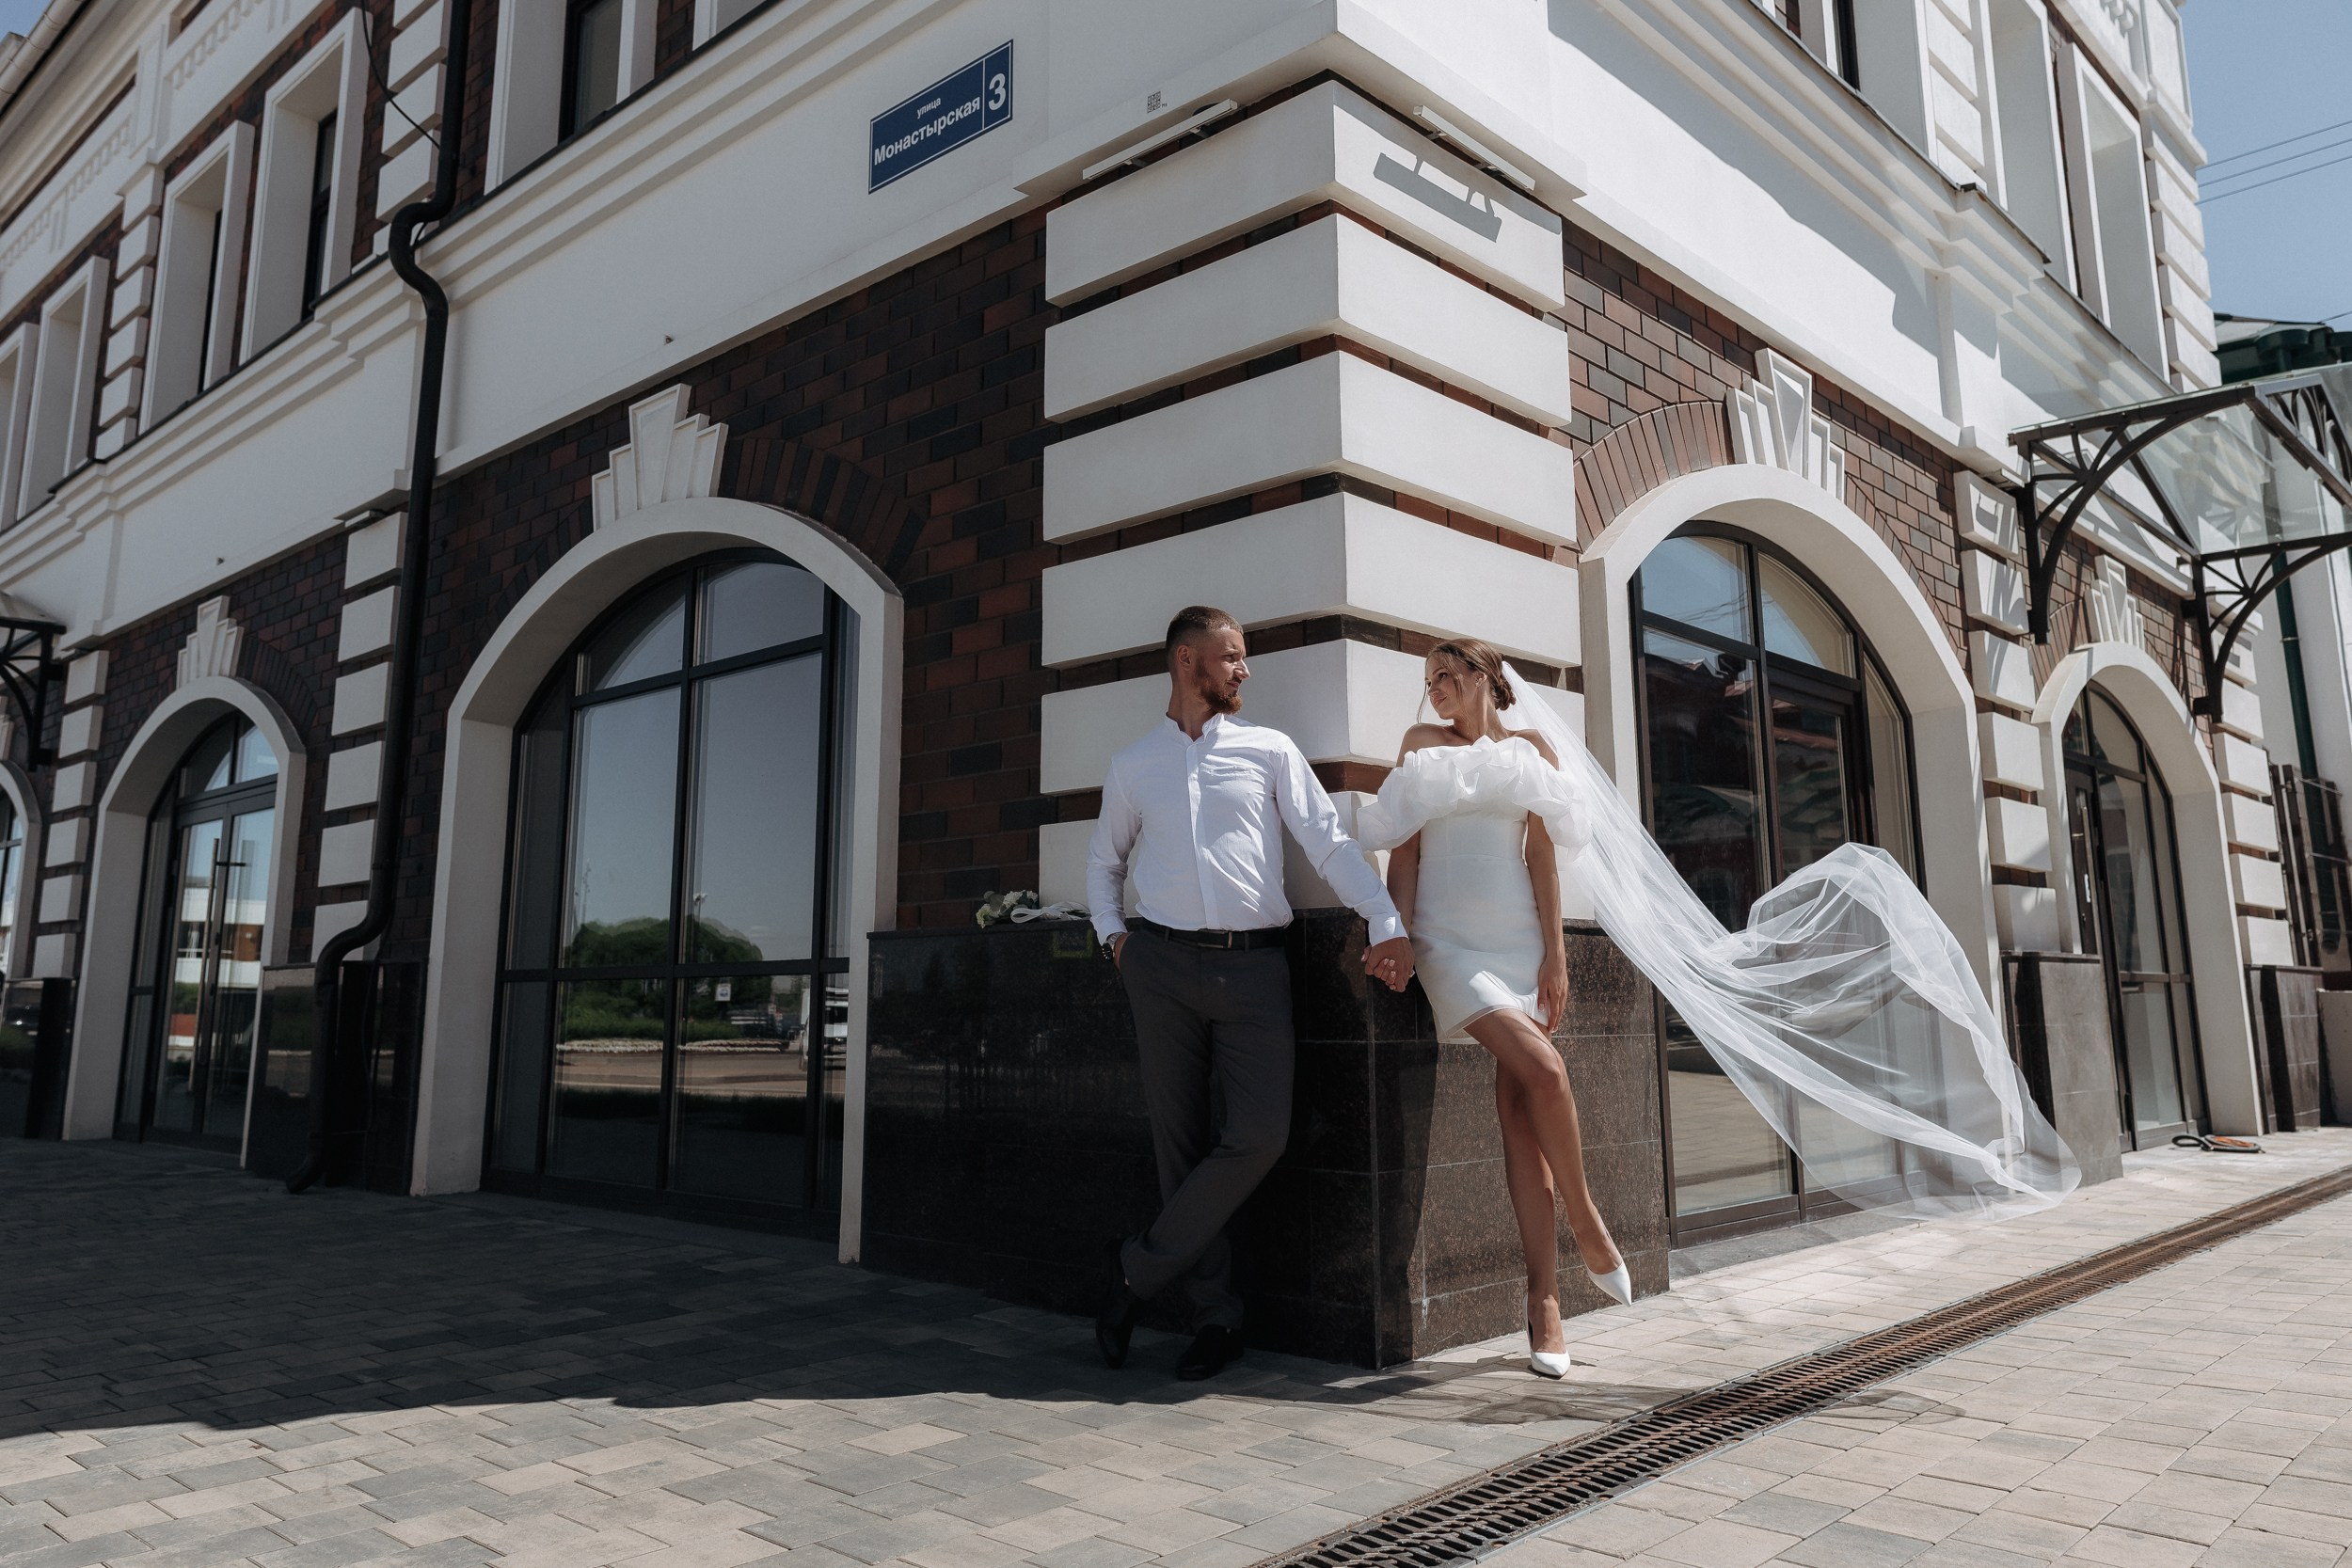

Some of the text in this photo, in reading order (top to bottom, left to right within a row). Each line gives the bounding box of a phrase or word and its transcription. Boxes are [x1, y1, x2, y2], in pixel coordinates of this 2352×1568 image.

[874, 73, 1006, 166] Монастырская 3
[916, 97, 941, 119] улица
